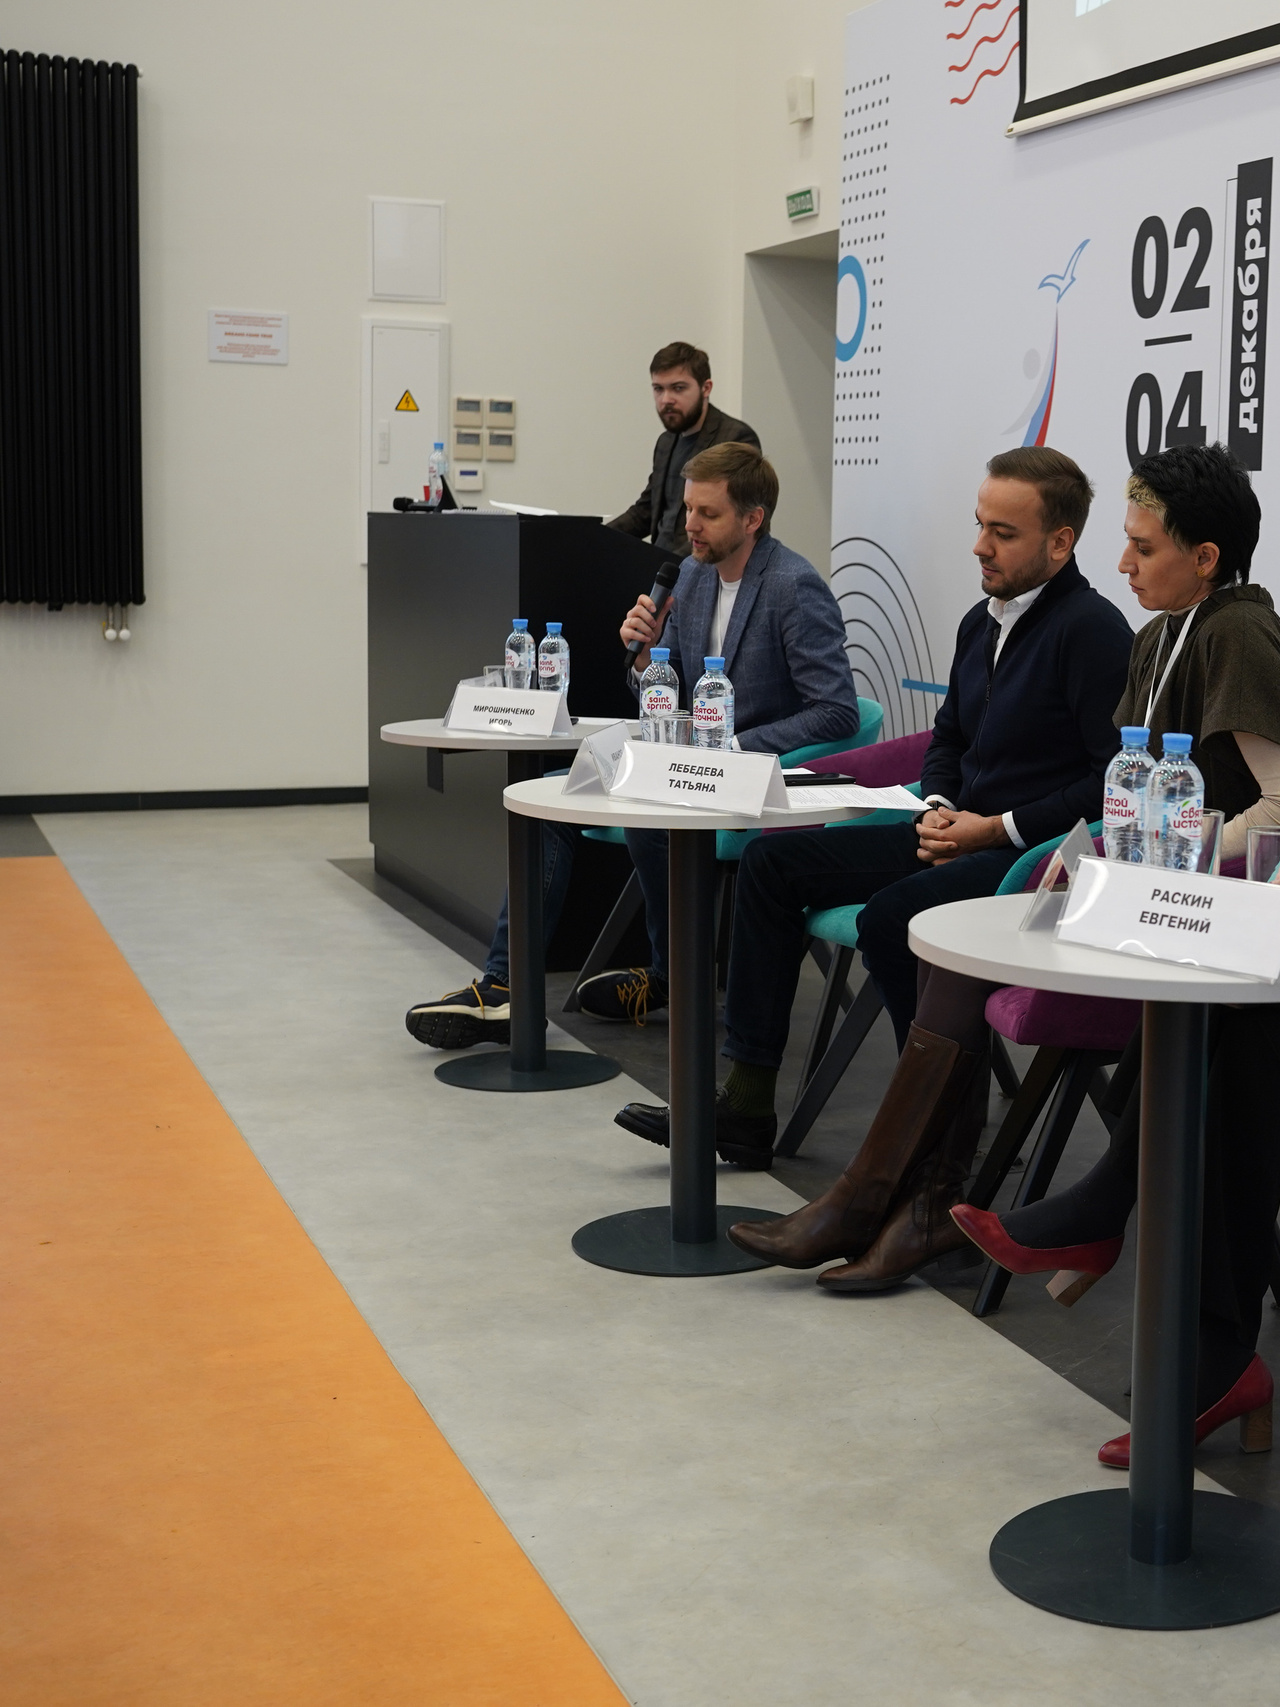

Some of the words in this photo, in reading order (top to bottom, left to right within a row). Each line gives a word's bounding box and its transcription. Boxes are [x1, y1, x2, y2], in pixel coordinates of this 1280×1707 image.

[1131, 206, 1213, 319] 02
[1237, 197, 1266, 434] декабря
[1125, 370, 1207, 472] 04
[473, 705, 535, 716] МИРОШНИЧЕНКО
[647, 703, 672, 712] spring
[489, 718, 512, 727] ИГОРЬ
[669, 763, 724, 778] ЛЕБЕДЕВА
[669, 779, 716, 793] ТАТЬЯНА
[1151, 888, 1213, 909] РАСКИН
[1139, 910, 1211, 933] ЕВГЕНИЙ
